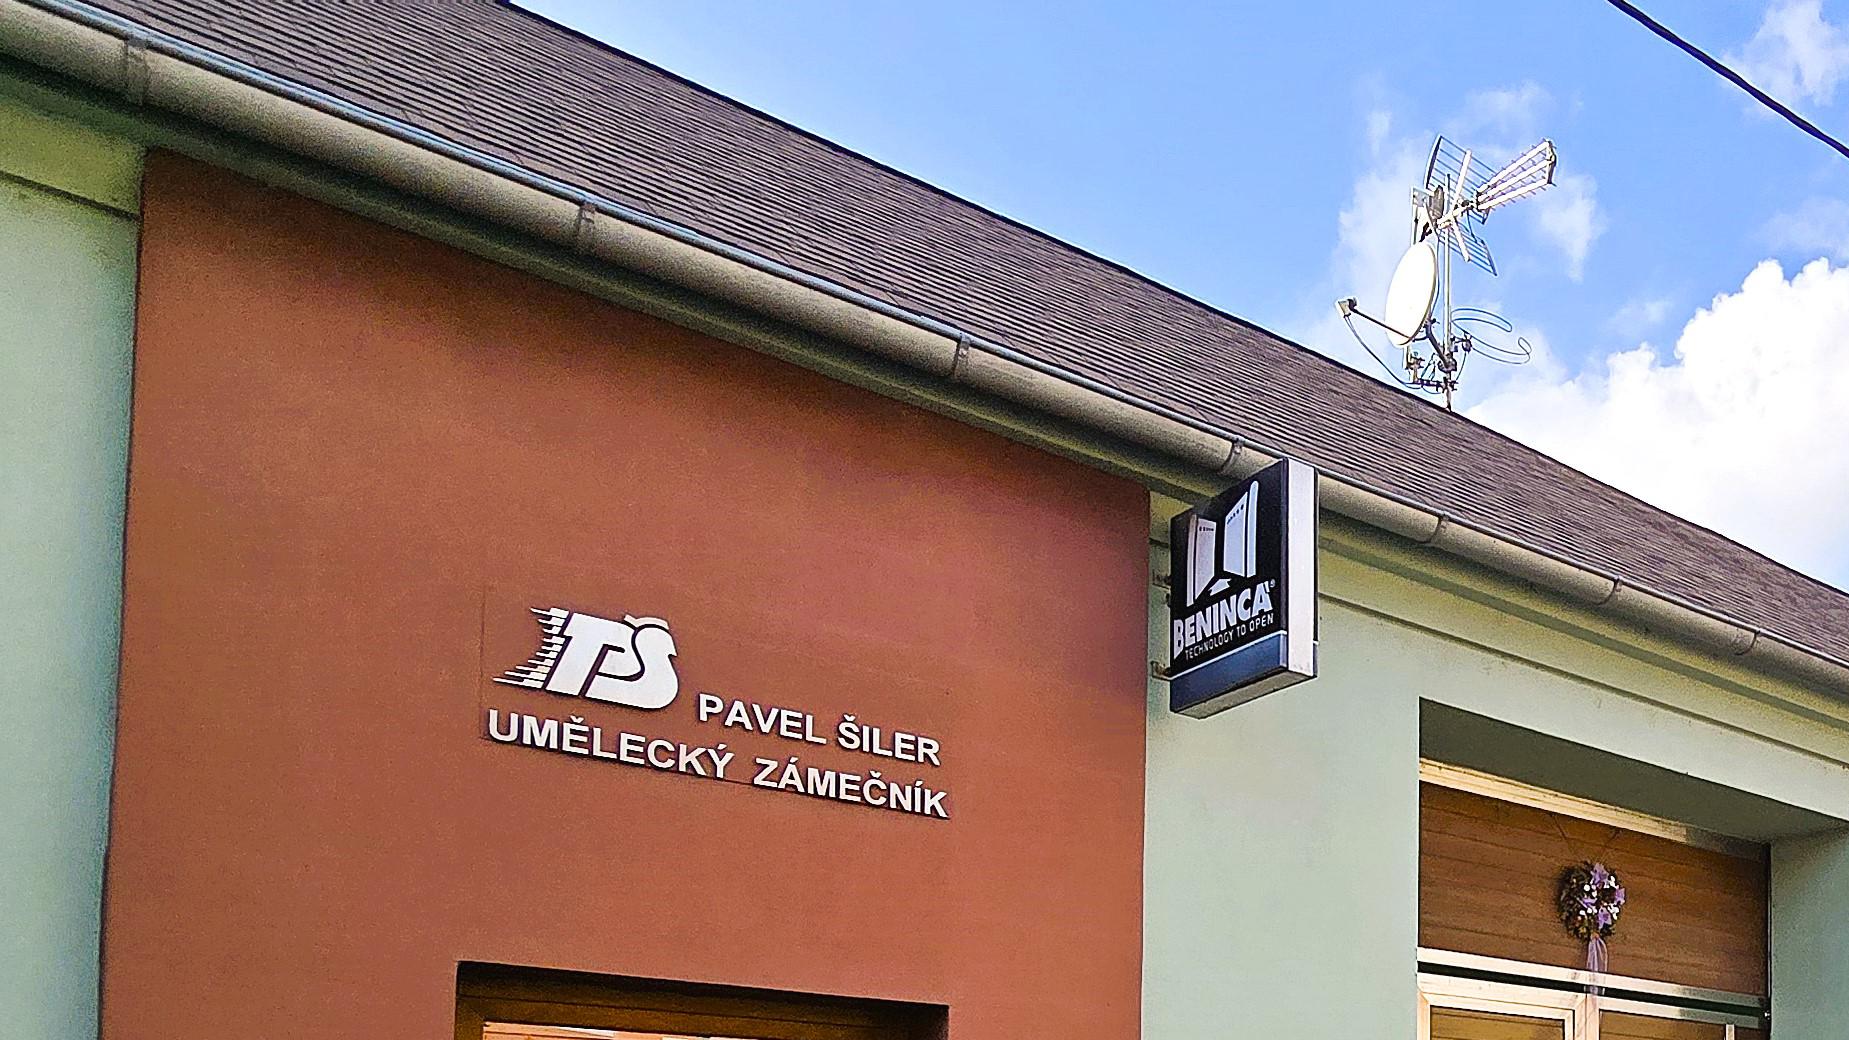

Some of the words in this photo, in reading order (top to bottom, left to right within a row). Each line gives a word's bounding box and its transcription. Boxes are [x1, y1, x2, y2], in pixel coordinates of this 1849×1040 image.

[1185, 629, 1234, 660] TECHNOLOGY
[1236, 624, 1247, 638] TO
[1249, 613, 1274, 632] OPEN
[488, 709, 735, 779] UMĚLECKÝ
[753, 756, 949, 818] ZÁMEČNÍK
[699, 693, 827, 745] PAVEL
[837, 715, 941, 766] ŠILER
